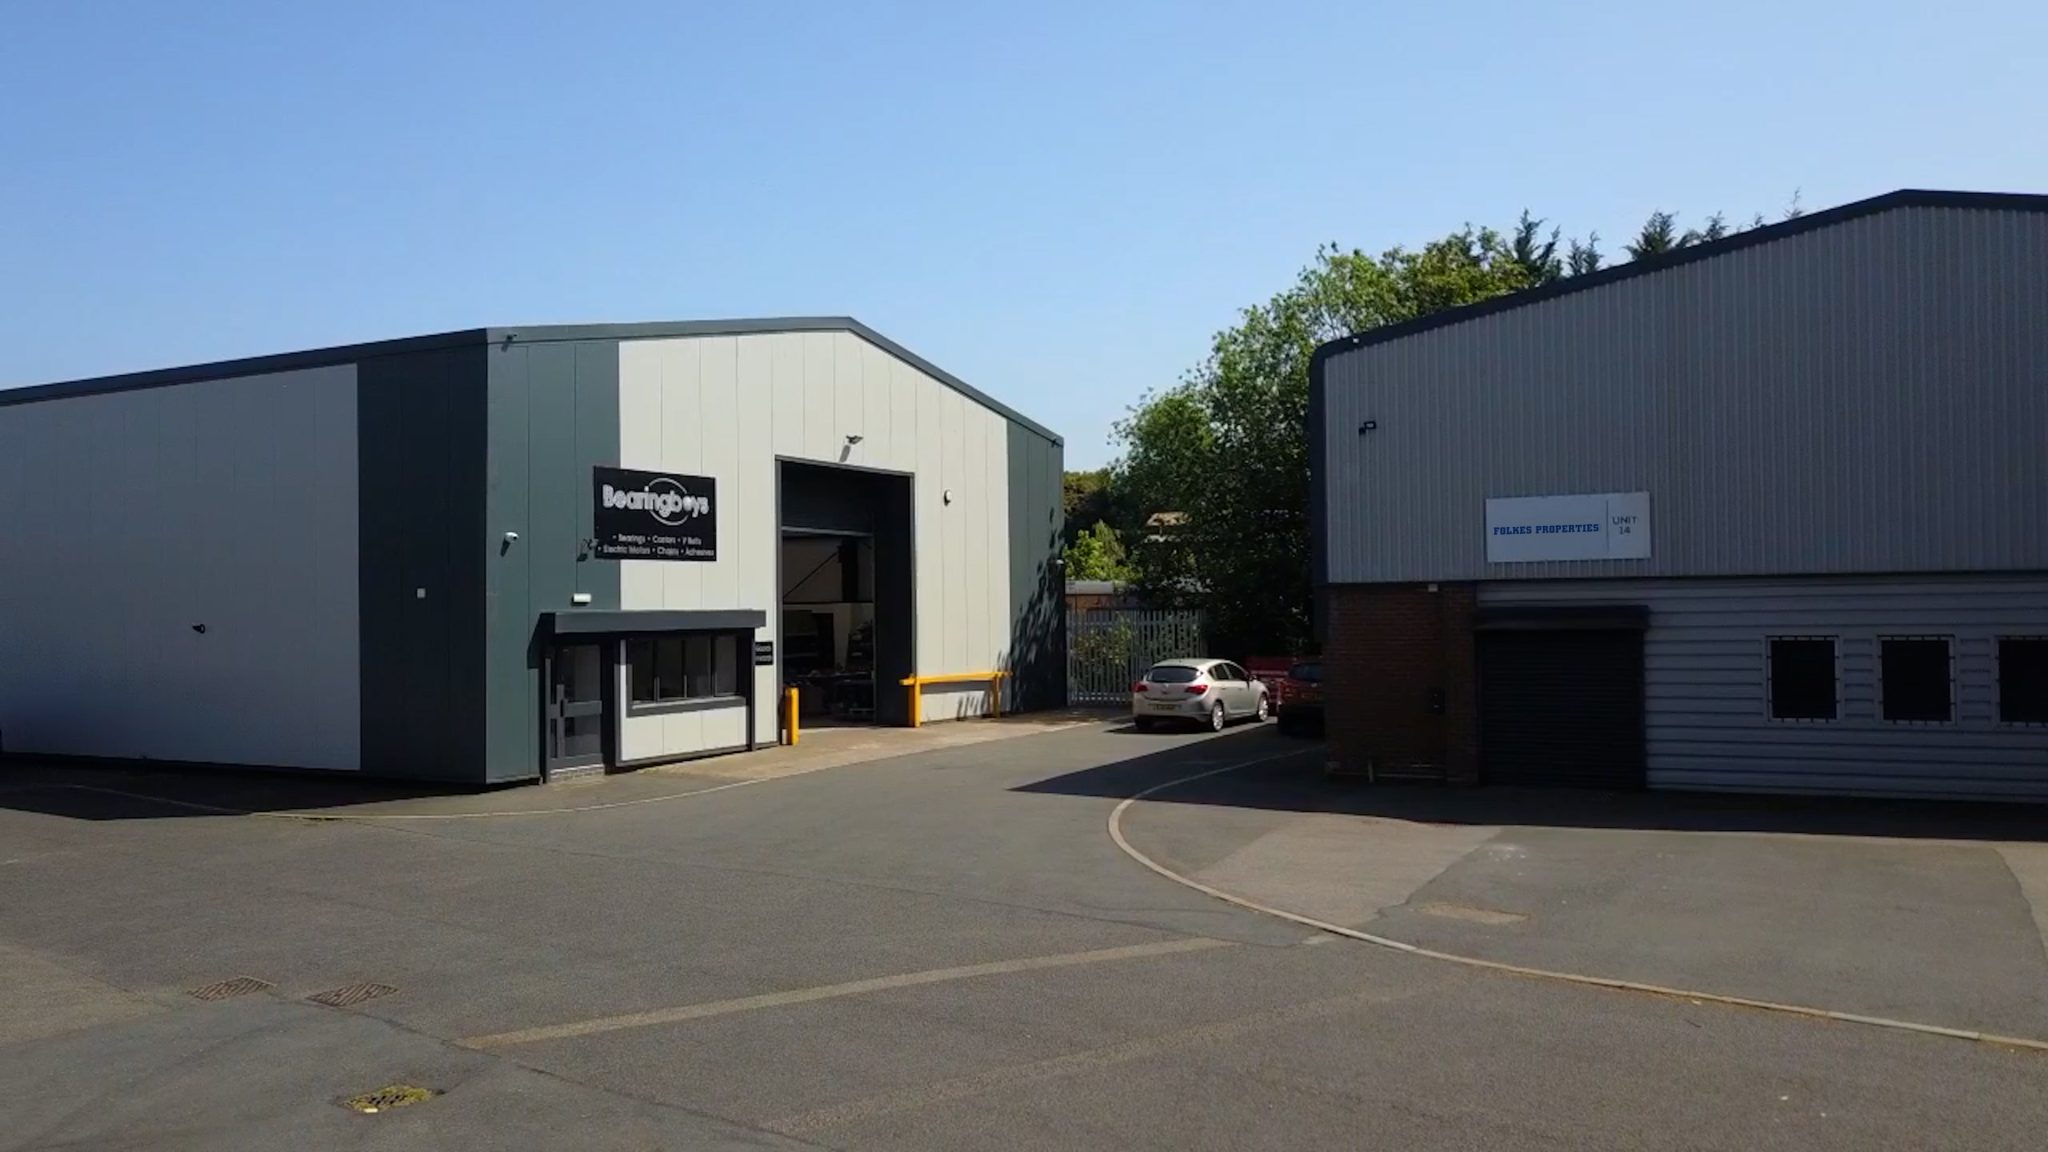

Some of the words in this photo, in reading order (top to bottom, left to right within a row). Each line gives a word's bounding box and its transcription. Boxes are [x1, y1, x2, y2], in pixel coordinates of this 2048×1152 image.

[602, 484, 709, 518] Bearingboys
[1612, 516, 1638, 525] UNIT
[1493, 525, 1532, 536] FOLKES
[1535, 523, 1600, 534] PROPERTIES
[1618, 526, 1631, 535] 14
